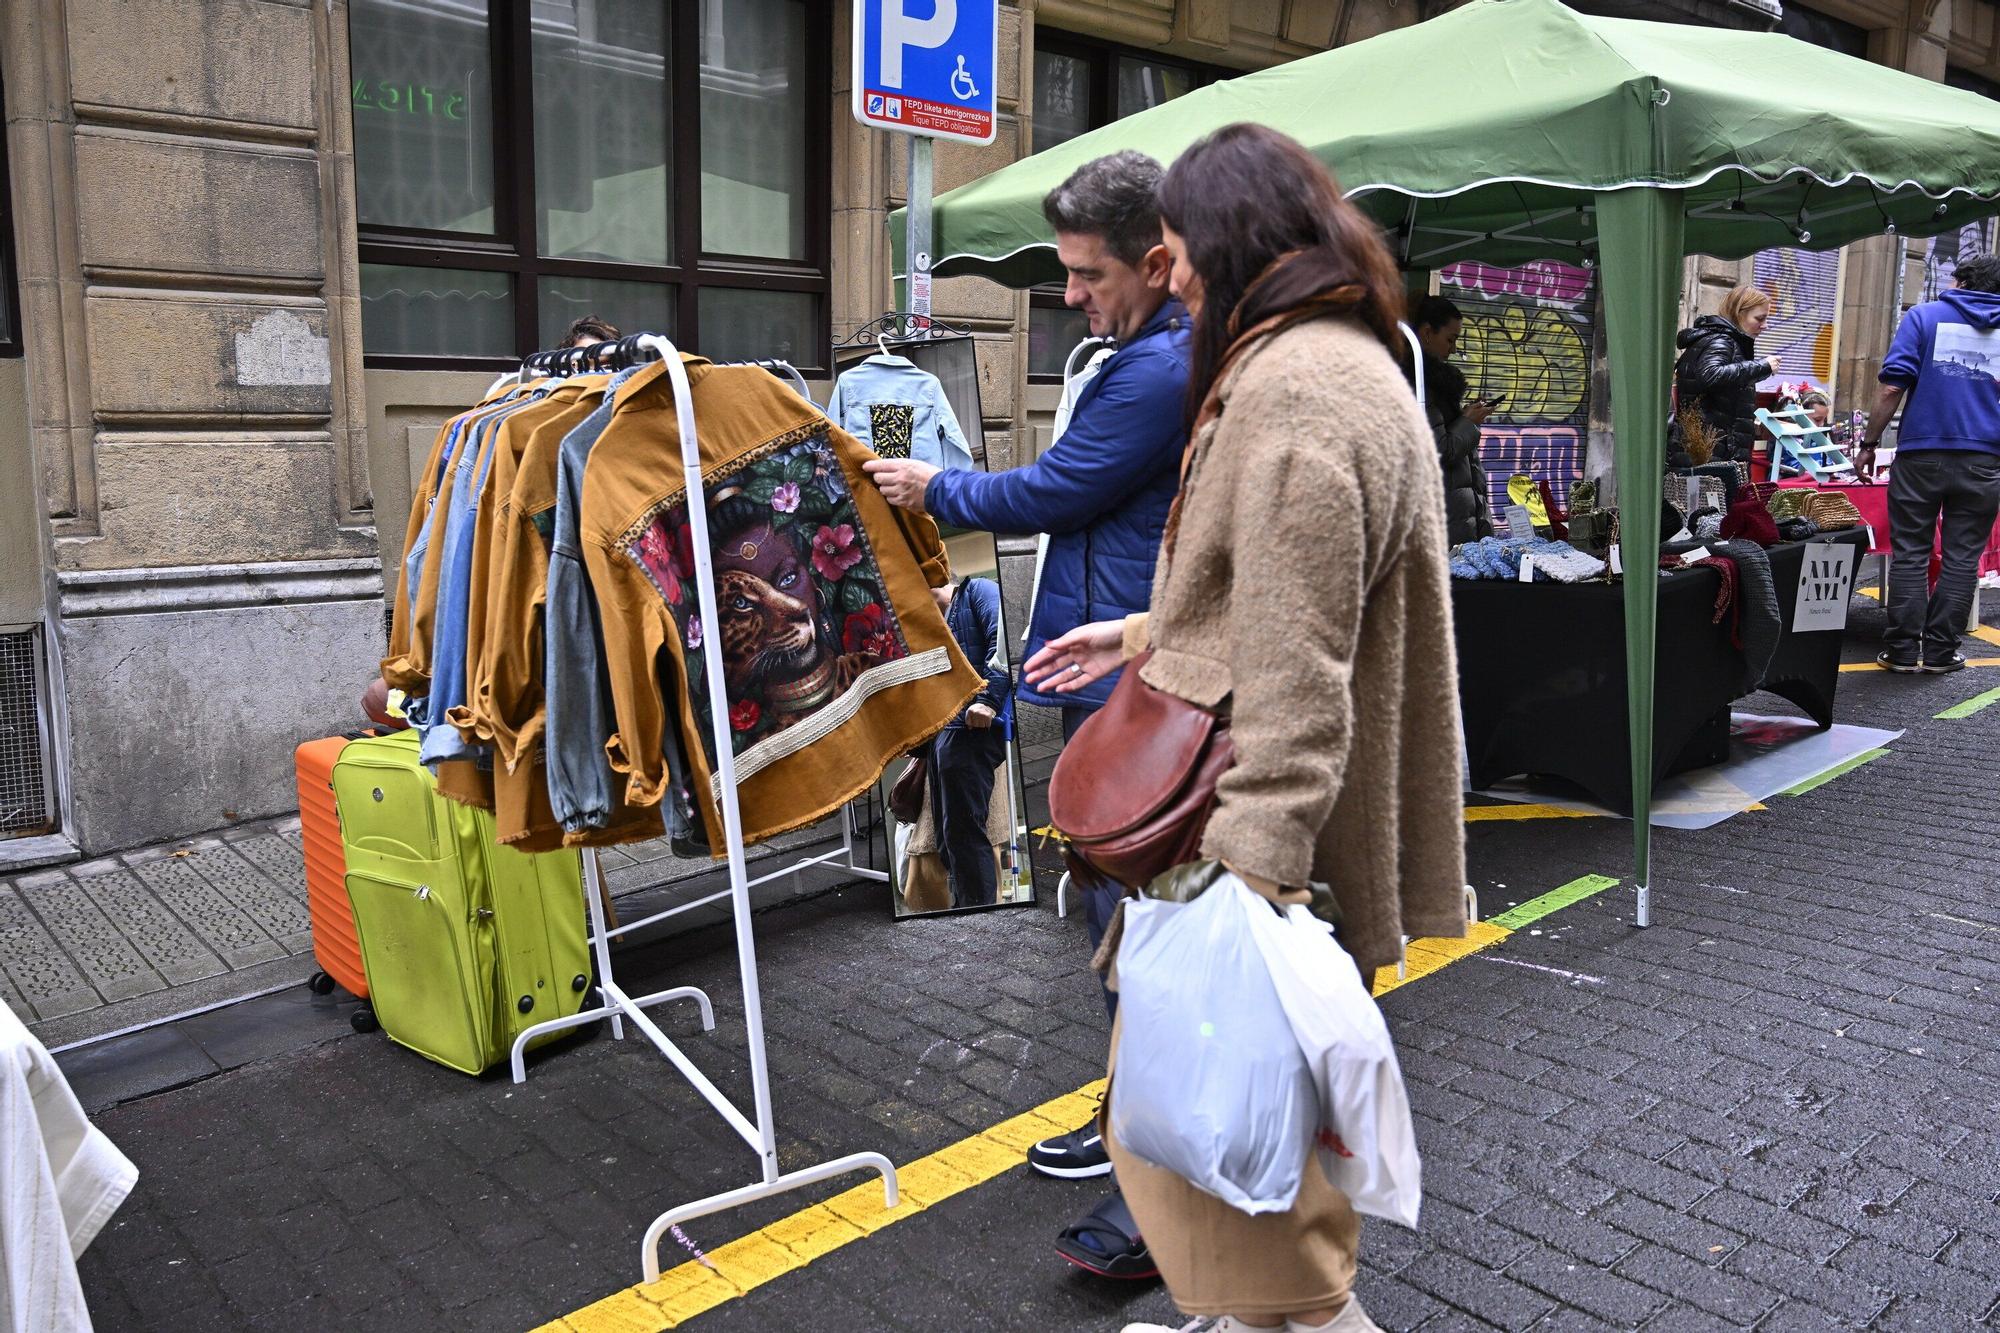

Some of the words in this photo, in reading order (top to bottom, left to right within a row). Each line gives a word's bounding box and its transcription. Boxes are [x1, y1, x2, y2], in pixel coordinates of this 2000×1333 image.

[880, 0, 957, 89] P
[903, 98, 923, 110] TEPD
[924, 103, 942, 113] tiketa
[943, 106, 990, 122] derrigorrezkoa
[912, 114, 930, 125] Tique
[930, 117, 950, 129] TEPD
[950, 123, 982, 134] obligatorio
